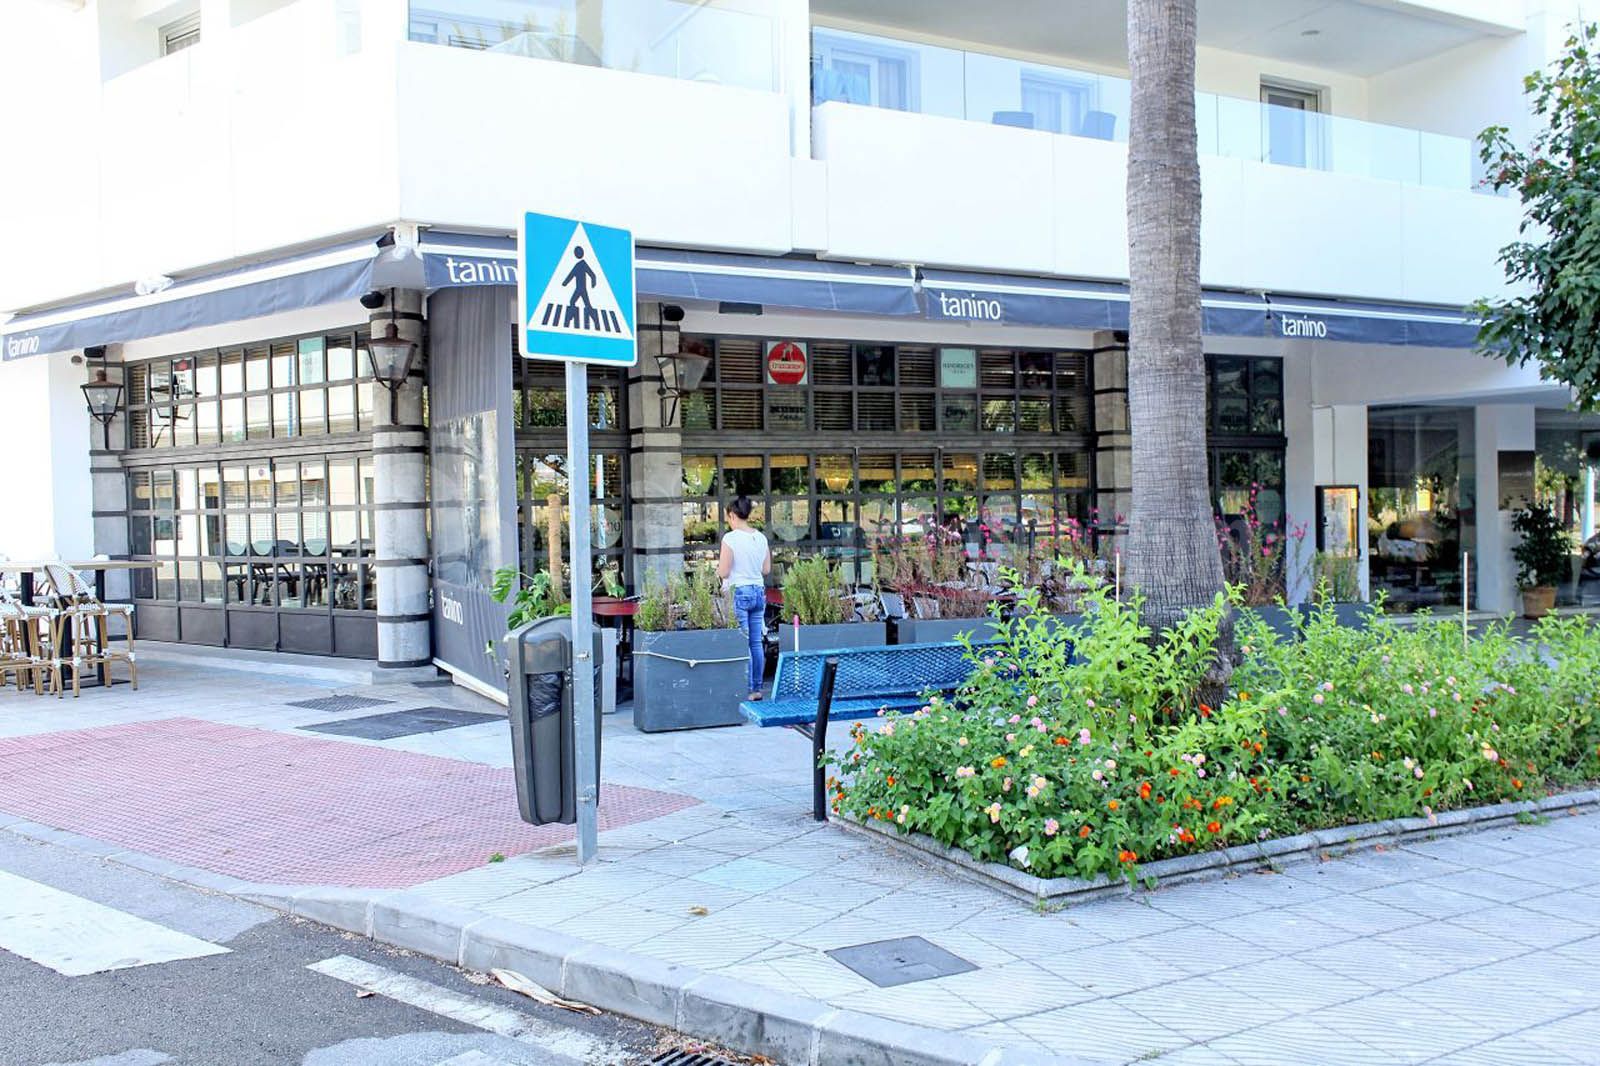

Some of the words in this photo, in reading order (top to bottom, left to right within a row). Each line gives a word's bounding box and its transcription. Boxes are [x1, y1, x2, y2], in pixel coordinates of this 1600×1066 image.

[445, 257, 517, 283] tanin
[940, 292, 1001, 320] tanino
[1281, 314, 1327, 338] tanino
[8, 336, 40, 358] tanino
[441, 590, 463, 624] tanino
